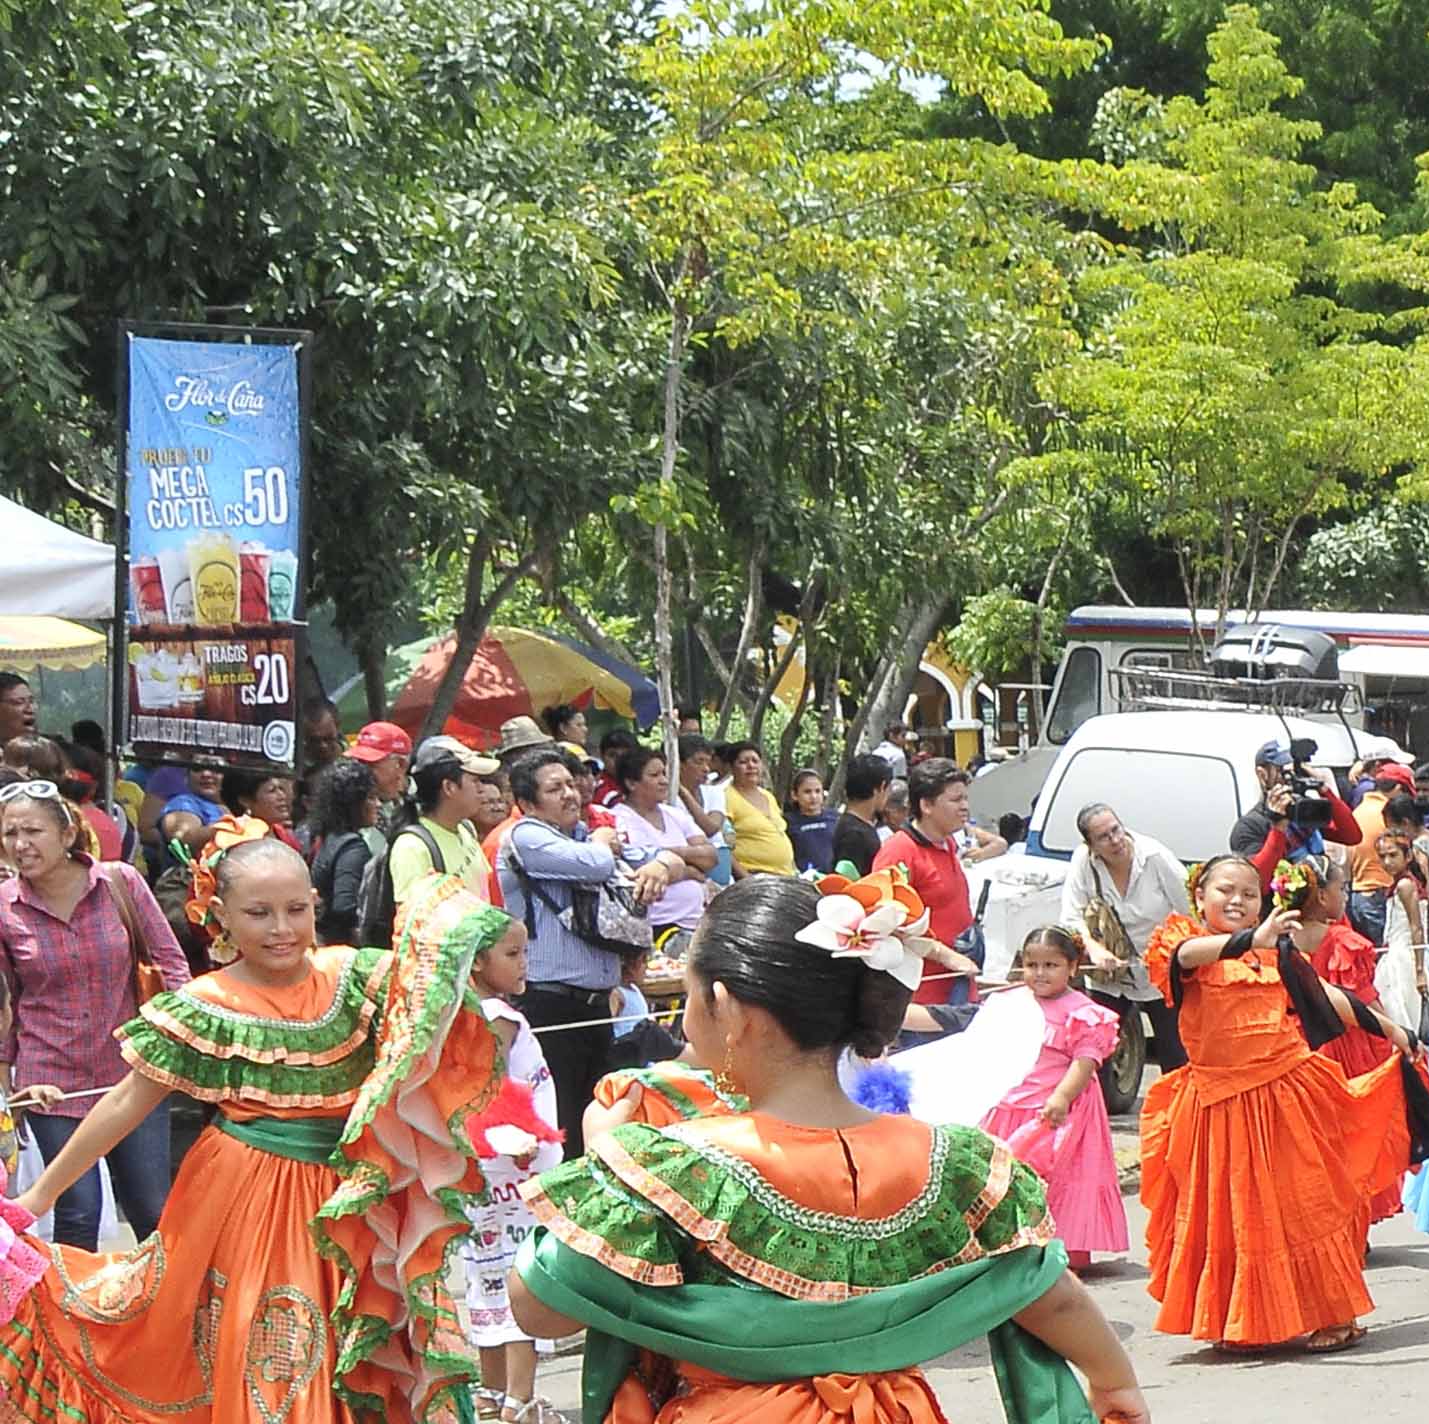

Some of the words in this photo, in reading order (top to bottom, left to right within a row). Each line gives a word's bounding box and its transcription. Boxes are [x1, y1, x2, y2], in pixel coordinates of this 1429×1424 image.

[165, 376, 213, 411] Flor
[227, 380, 265, 416] Caña
[150, 465, 210, 499] MEGA
[147, 497, 221, 530] COCTEL
[204, 645, 249, 664] TRAGOS
